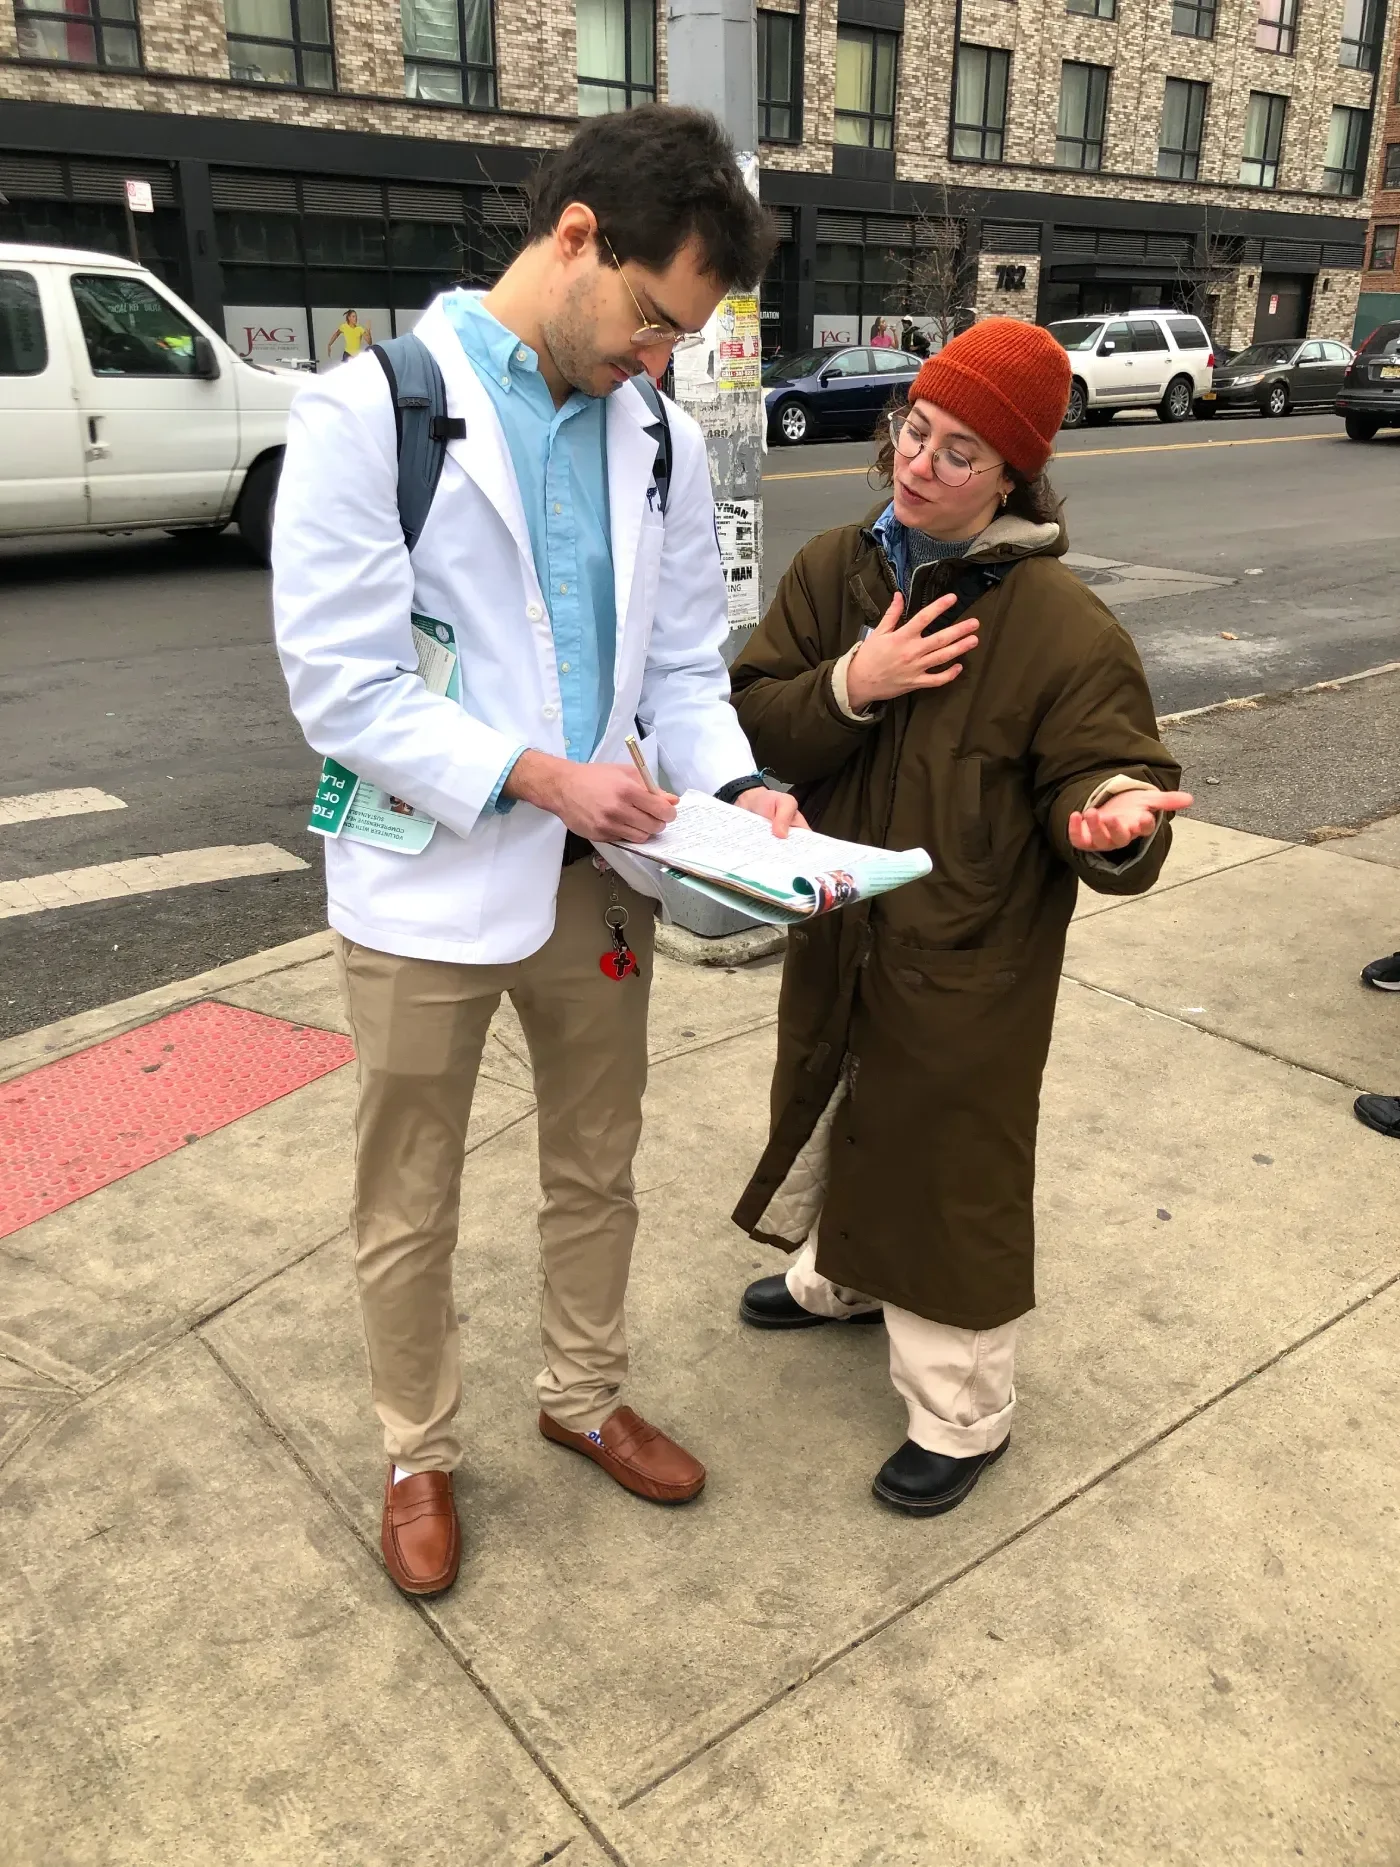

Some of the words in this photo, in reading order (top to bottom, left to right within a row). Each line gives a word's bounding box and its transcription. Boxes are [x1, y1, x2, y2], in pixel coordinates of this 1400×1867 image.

[239, 327, 297, 358] JAG
[820, 331, 850, 348] JAG
[731, 565, 752, 582] MAN
[726, 584, 741, 592] ING
[320, 773, 346, 789] PLA
[321, 792, 340, 804] OF
[312, 804, 335, 819] FIG
[356, 824, 370, 834] WITH
[358, 817, 405, 834] COMPREHENSIVE
[370, 825, 404, 840] VOLUNTEER
